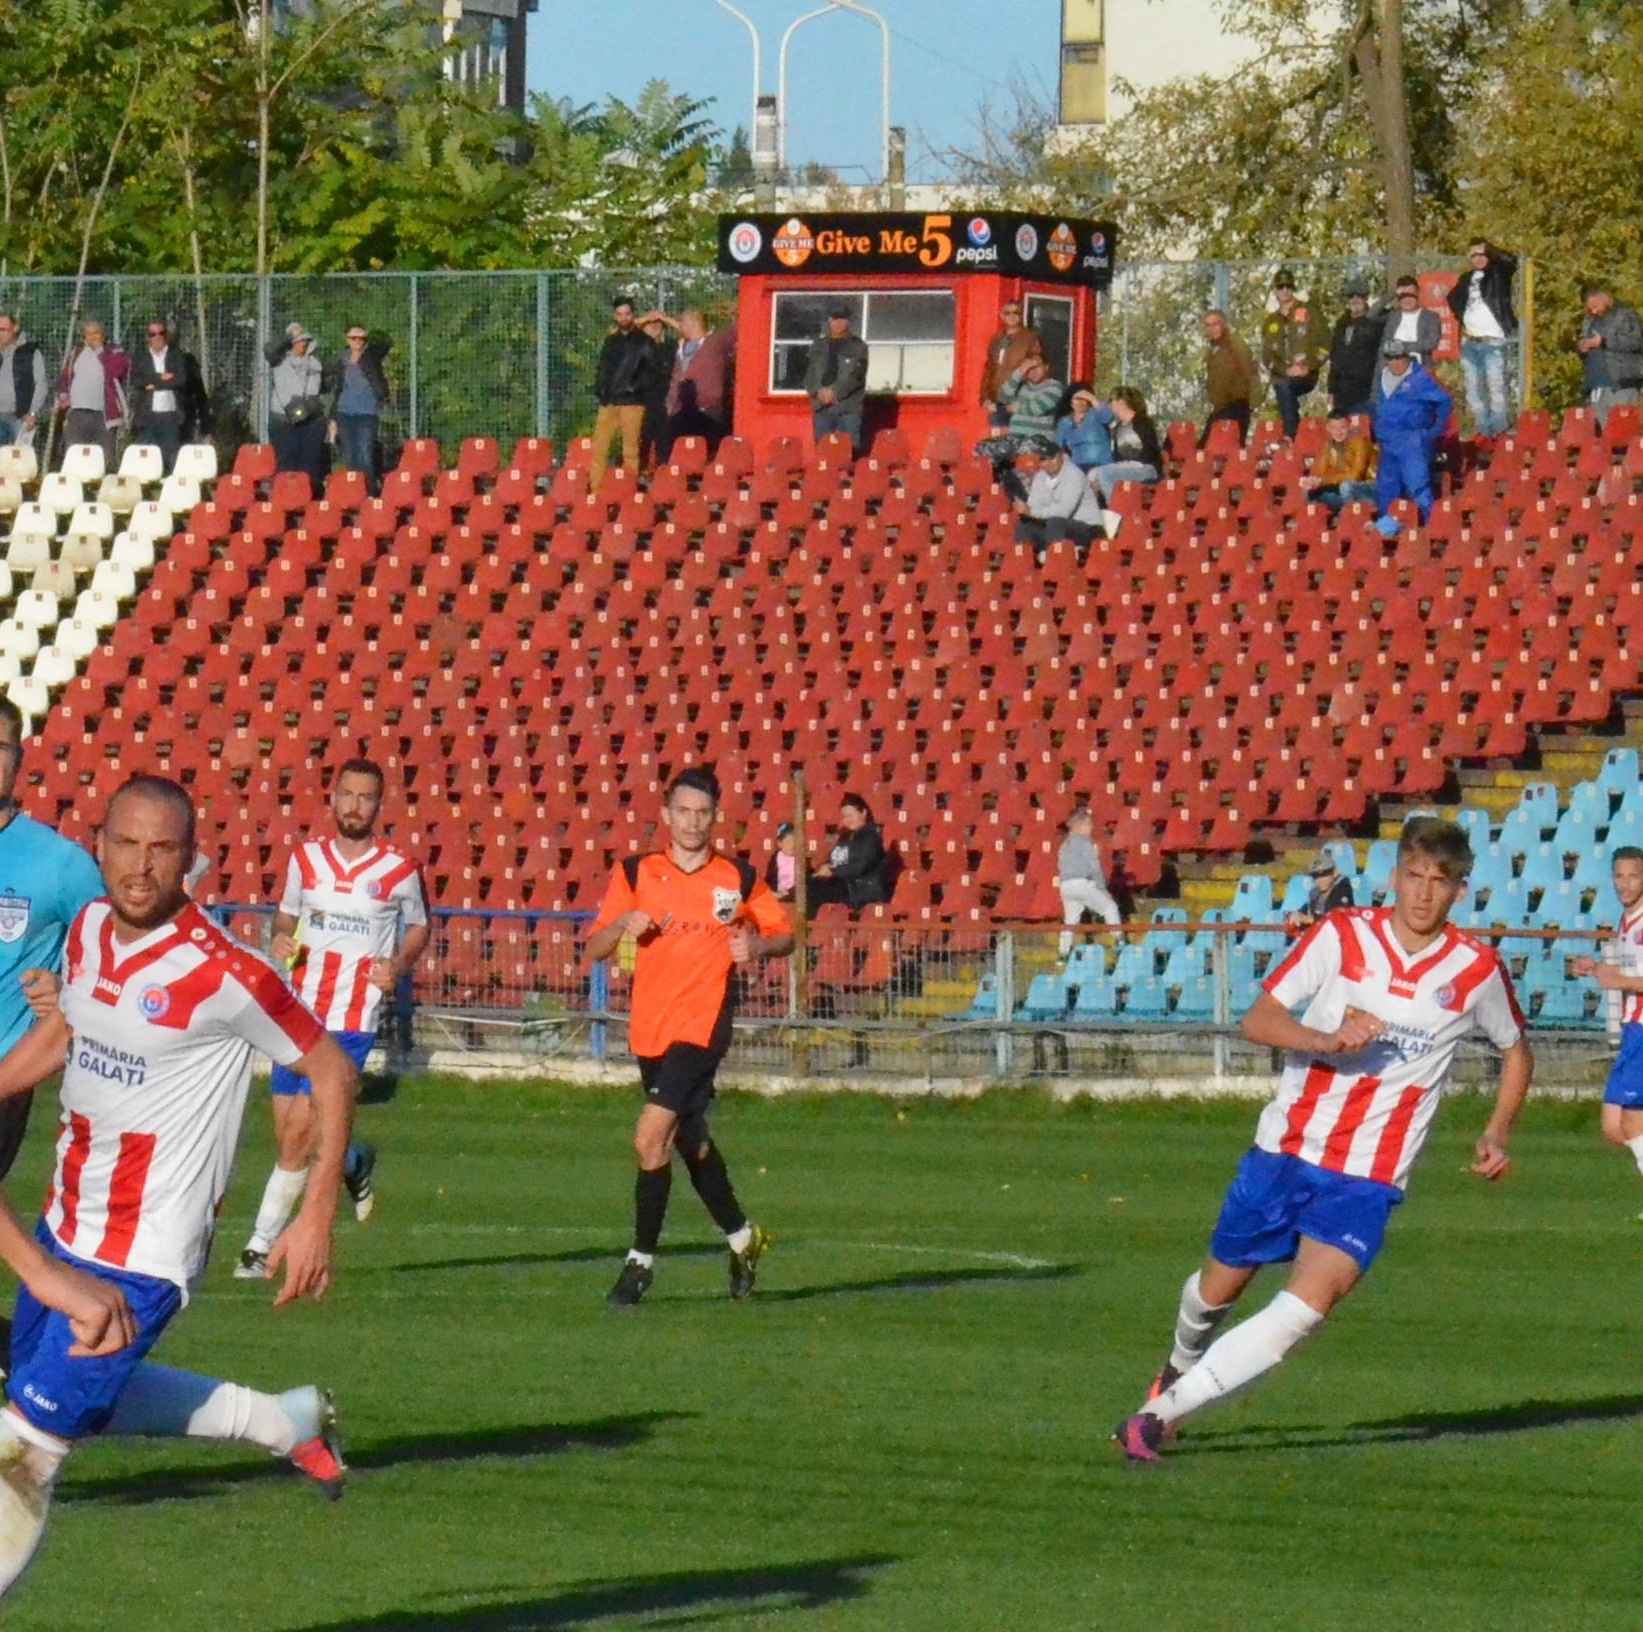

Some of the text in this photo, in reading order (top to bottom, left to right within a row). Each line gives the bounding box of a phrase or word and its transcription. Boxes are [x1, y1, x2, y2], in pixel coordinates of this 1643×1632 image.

[772, 238, 814, 249] GIVE ME
[816, 215, 953, 267] Give Me 5
[956, 245, 998, 265] pepsi
[1083, 256, 1109, 269] pepsi
[97, 977, 122, 997] JAKO
